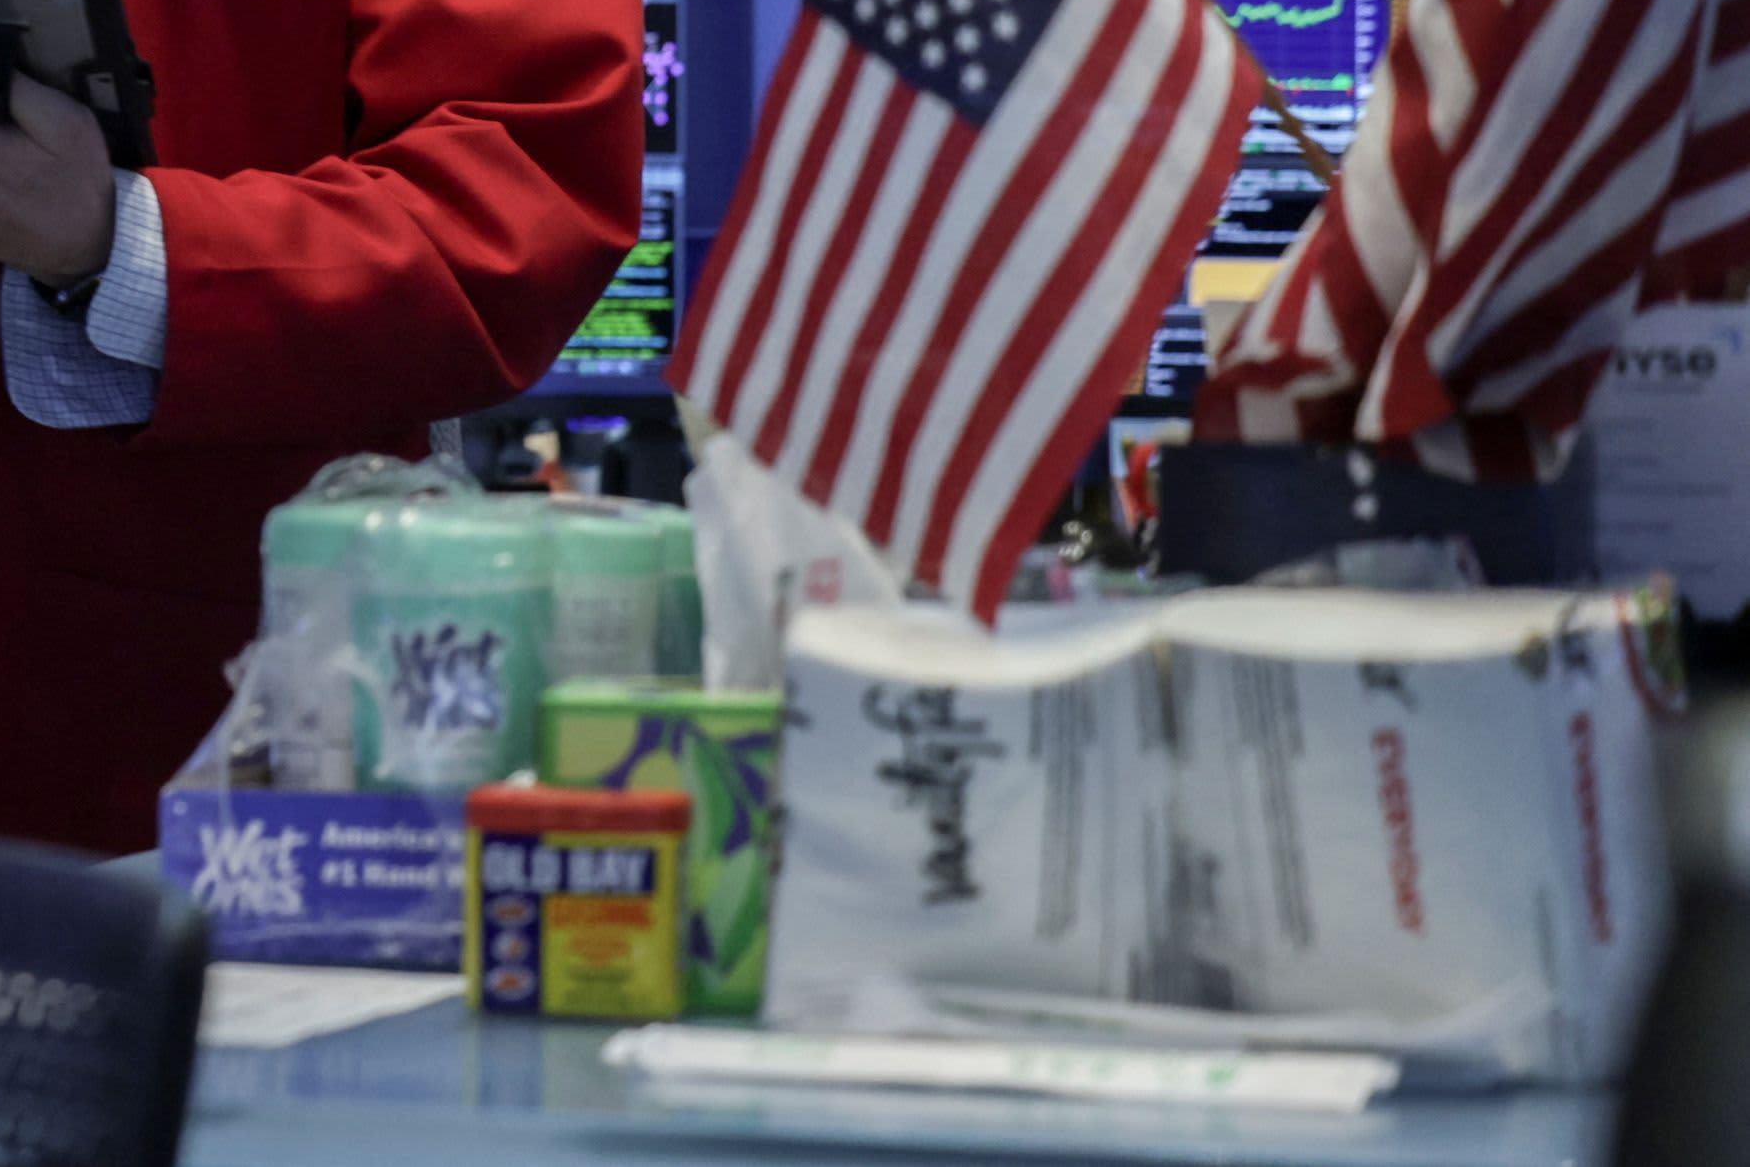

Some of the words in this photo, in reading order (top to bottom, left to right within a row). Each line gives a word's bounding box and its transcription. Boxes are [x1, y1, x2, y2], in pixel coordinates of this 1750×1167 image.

[201, 819, 308, 880] Wet
[1369, 726, 1426, 936] EVERYDAY
[482, 842, 559, 893] OLD
[568, 845, 647, 894] BAY
